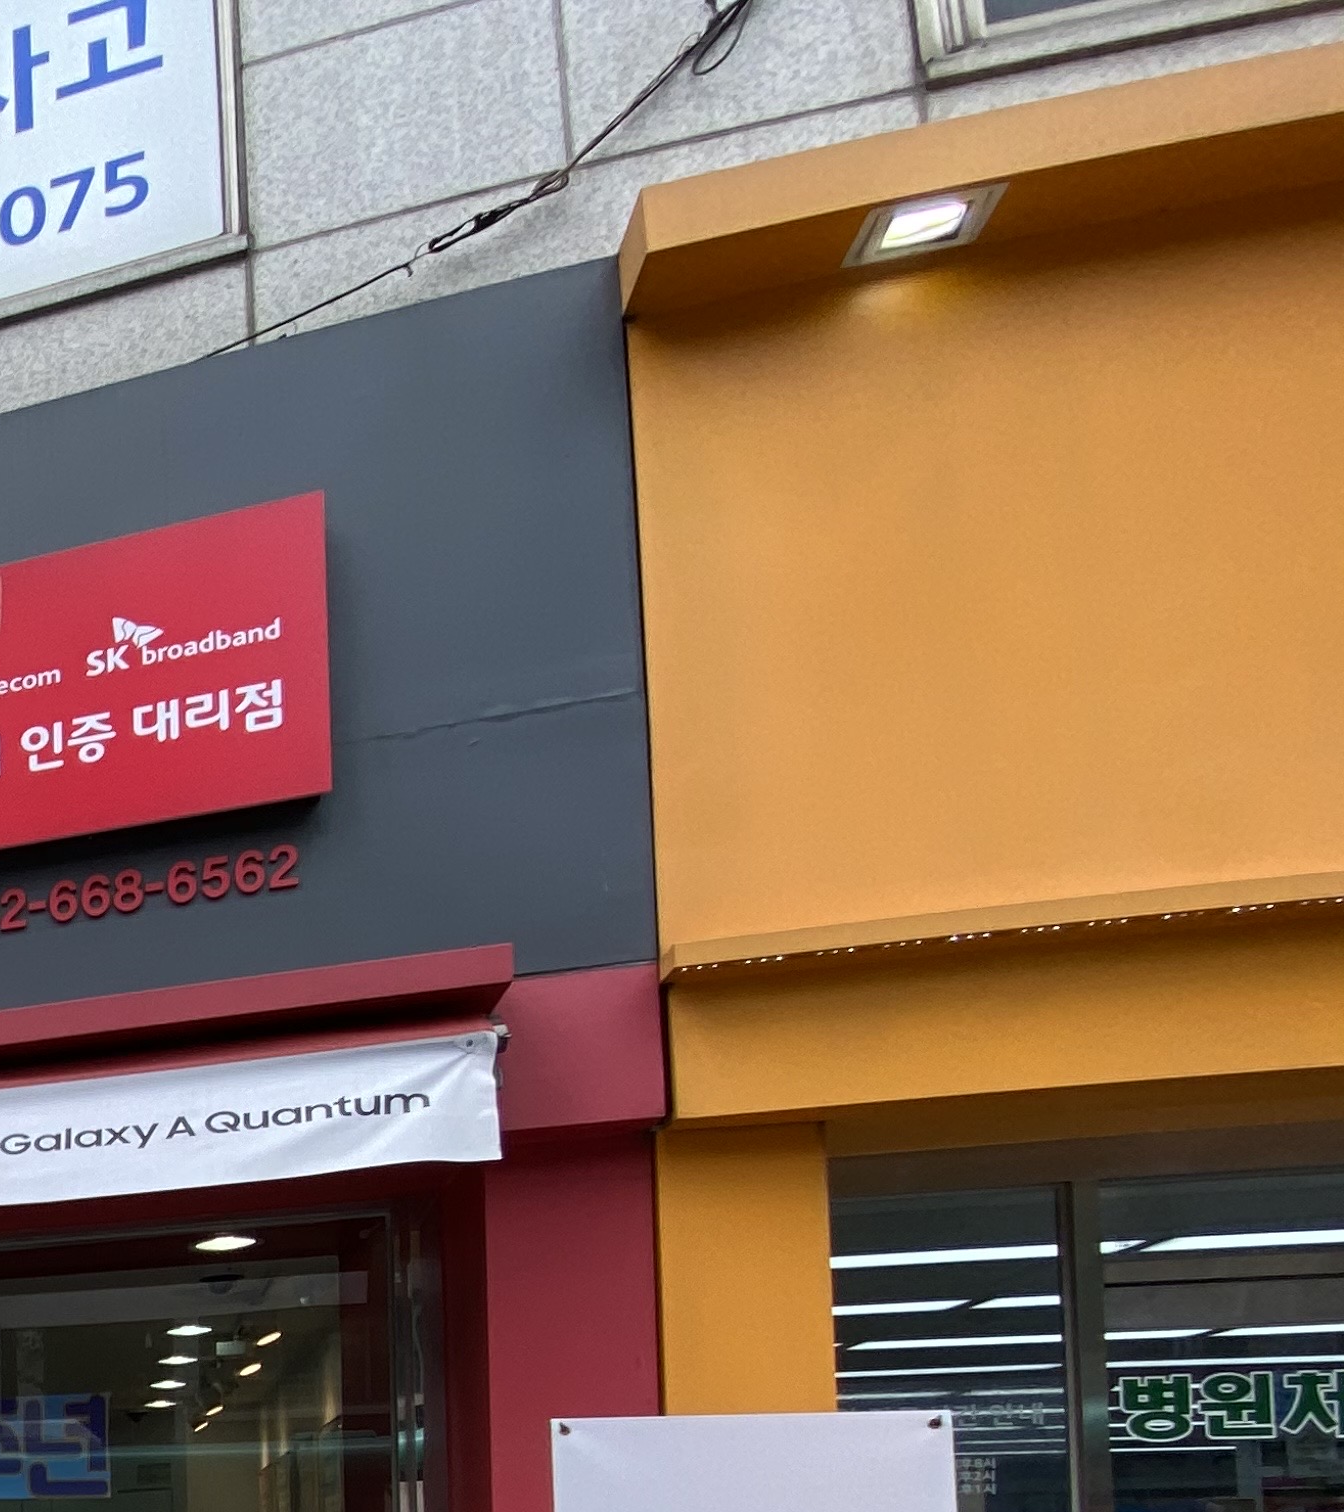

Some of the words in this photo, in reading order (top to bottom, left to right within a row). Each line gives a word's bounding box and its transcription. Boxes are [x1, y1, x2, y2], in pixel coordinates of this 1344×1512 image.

[86, 645, 131, 677] SK
[141, 616, 282, 666] broadband
[19, 711, 117, 774] 인증
[133, 678, 285, 744] 대리점
[0, 1124, 159, 1156] Galaxy
[166, 1115, 195, 1139] A
[206, 1090, 431, 1134] Quantum
